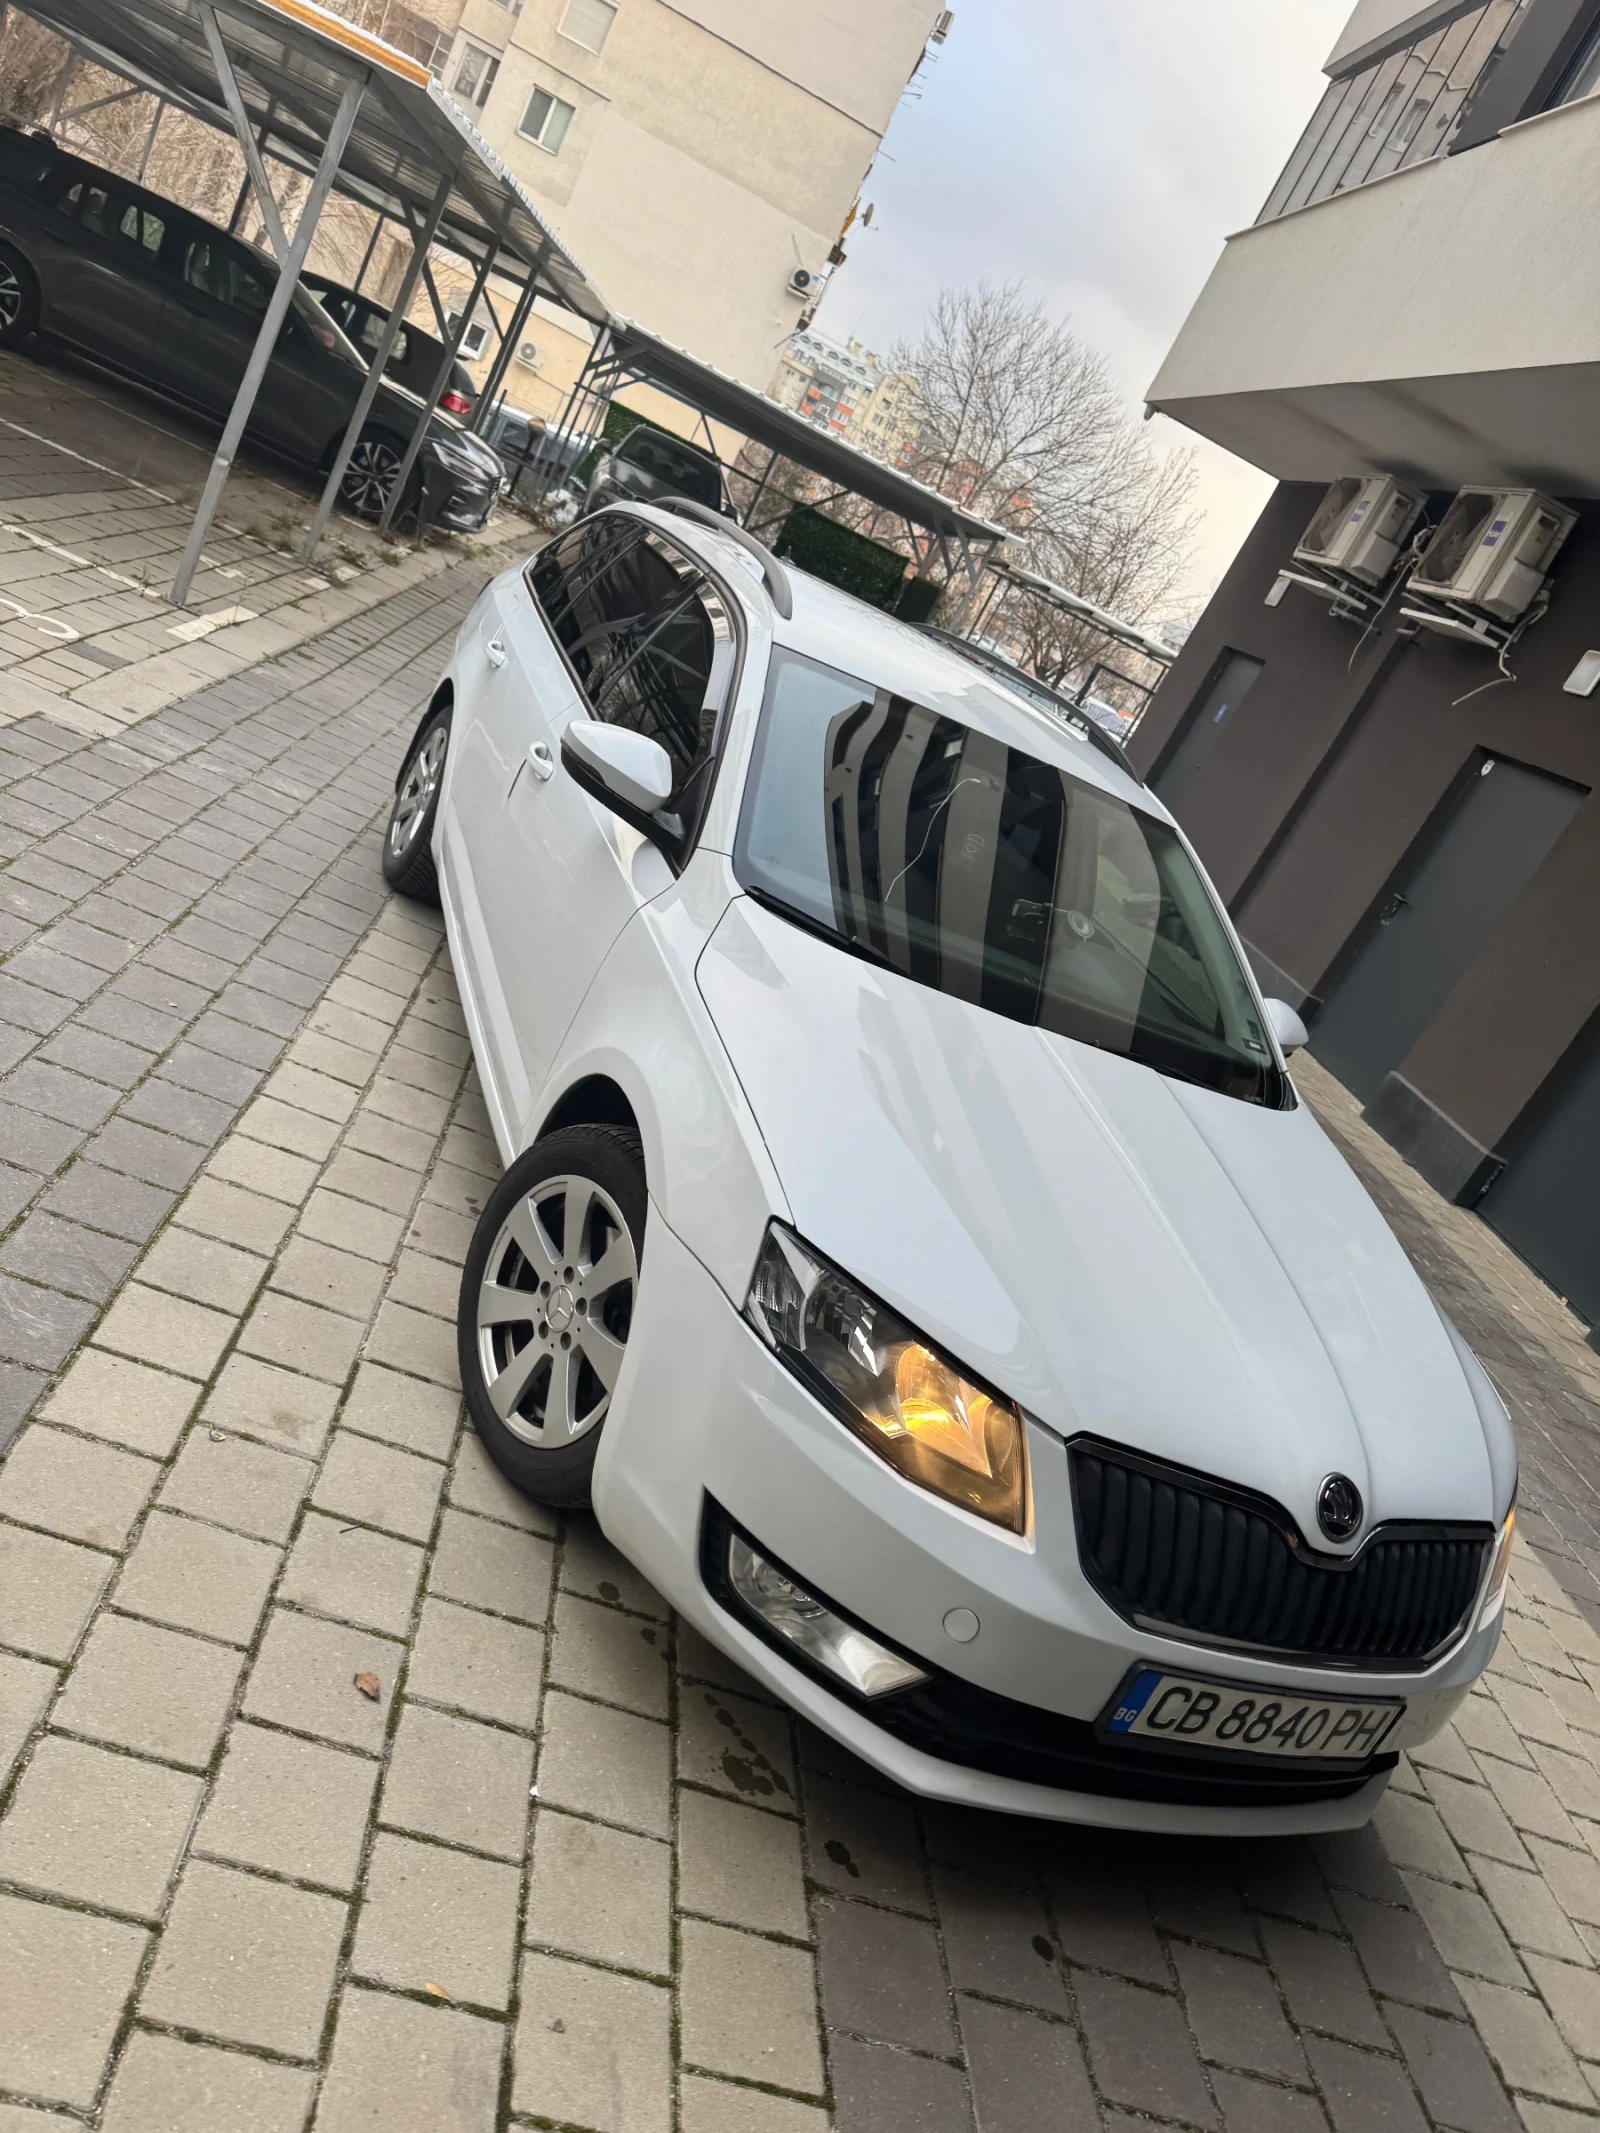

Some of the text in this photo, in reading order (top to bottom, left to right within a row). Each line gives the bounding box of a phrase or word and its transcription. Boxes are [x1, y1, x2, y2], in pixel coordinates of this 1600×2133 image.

[1112, 1707, 1137, 1722] BG
[1147, 1686, 1390, 1751] CB 8840 PH
